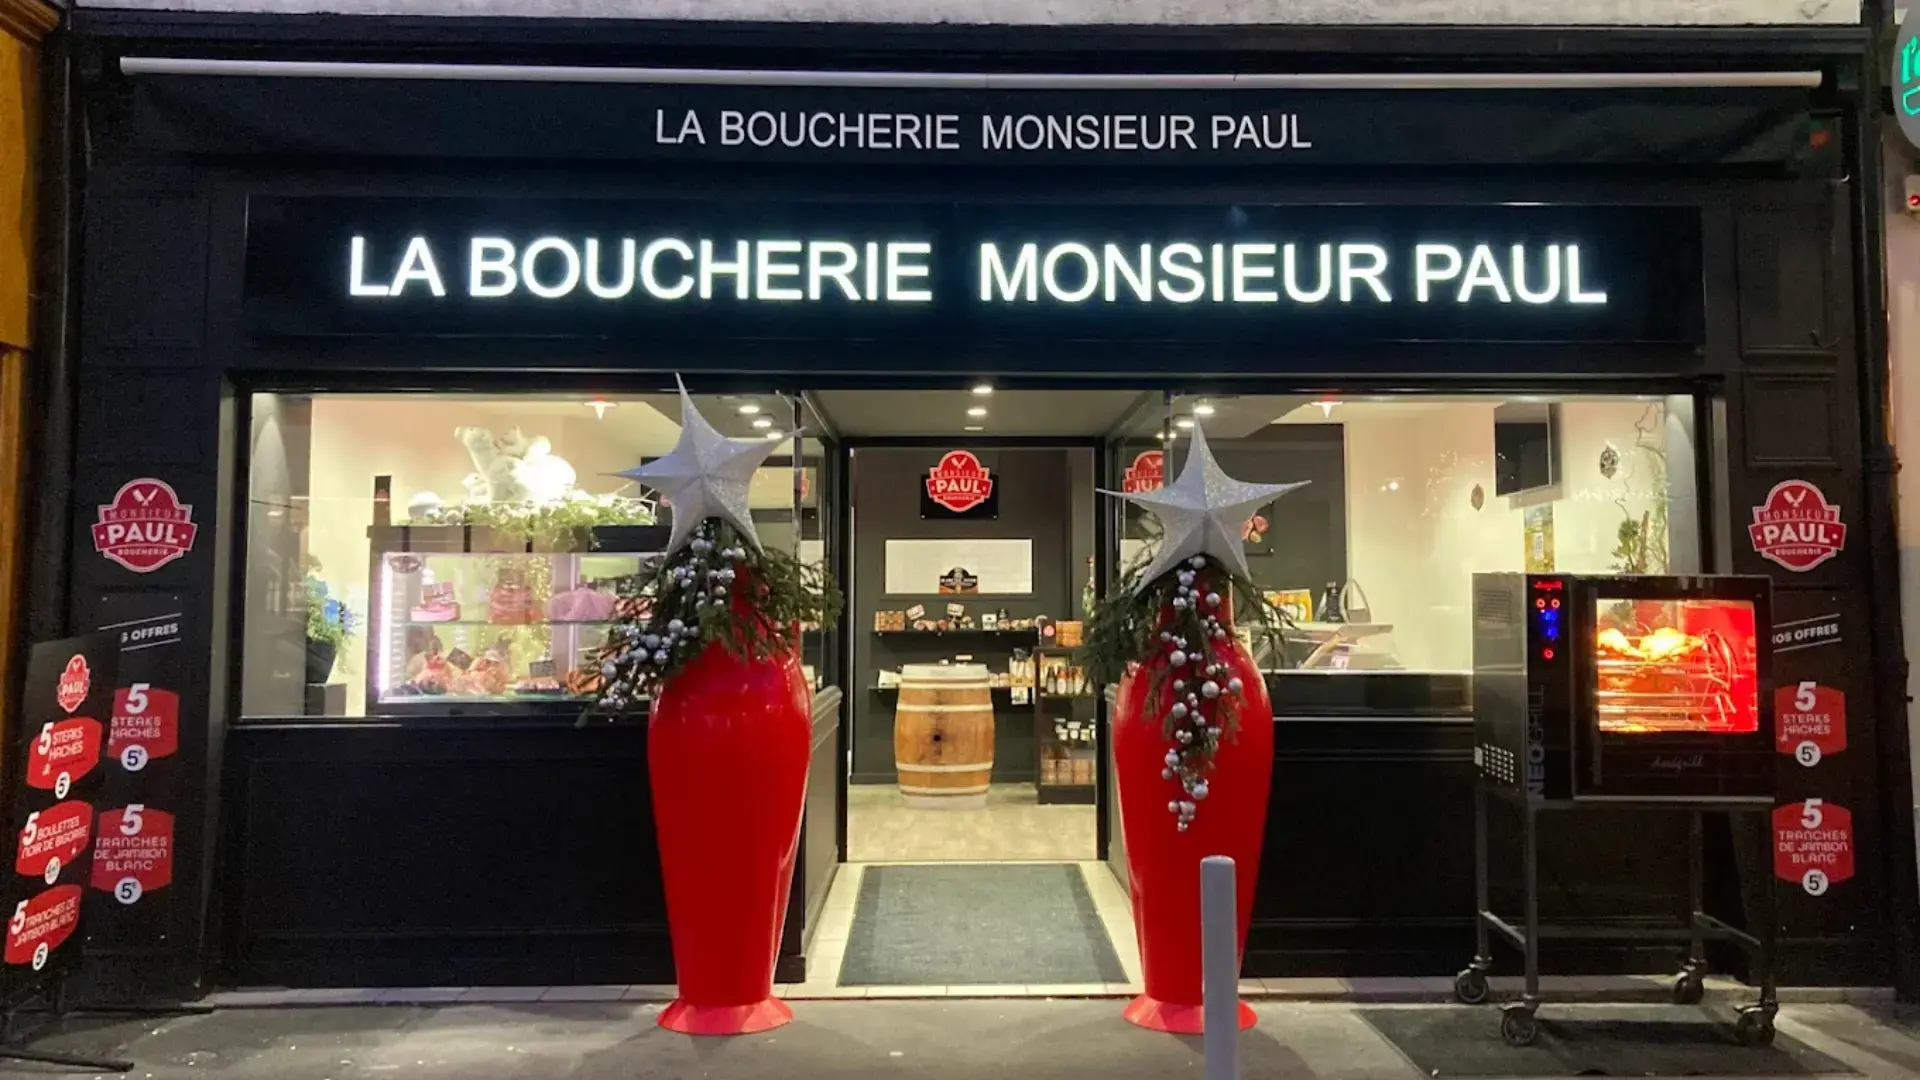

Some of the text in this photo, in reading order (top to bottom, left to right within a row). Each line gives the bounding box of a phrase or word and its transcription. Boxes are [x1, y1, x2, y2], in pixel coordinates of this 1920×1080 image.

[656, 109, 1312, 150] LA BOUCHERIE MONSIEUR PAUL
[349, 236, 1607, 304] LA BOUCHERIE MONSIEUR PAUL
[936, 478, 981, 493] PAUL
[109, 508, 182, 520] MONSIEUR
[1763, 508, 1832, 520] MONSIEUR
[107, 522, 178, 544] PAUL
[1763, 523, 1831, 545] PAUL
[131, 623, 178, 641] OFFRES
[1794, 623, 1838, 640] OFFRES
[125, 683, 150, 714] 5
[1794, 681, 1817, 711] 5
[111, 716, 161, 727] STEAKS
[1783, 714, 1831, 723] STEAKS
[38, 722, 54, 755] 5
[120, 803, 144, 835] 5
[1801, 798, 1823, 829] 5
[22, 811, 80, 845] 5 BOULETTES
[1778, 830, 1848, 841] TRANCHES
[43, 837, 55, 852] DE
[96, 836, 167, 847] TRANCHES
[1779, 841, 1848, 852] DE JAMBON
[93, 848, 167, 859] DE JAMBON
[1792, 853, 1836, 864] BLANC
[105, 860, 153, 871] BLANC
[11, 899, 29, 934] 5
